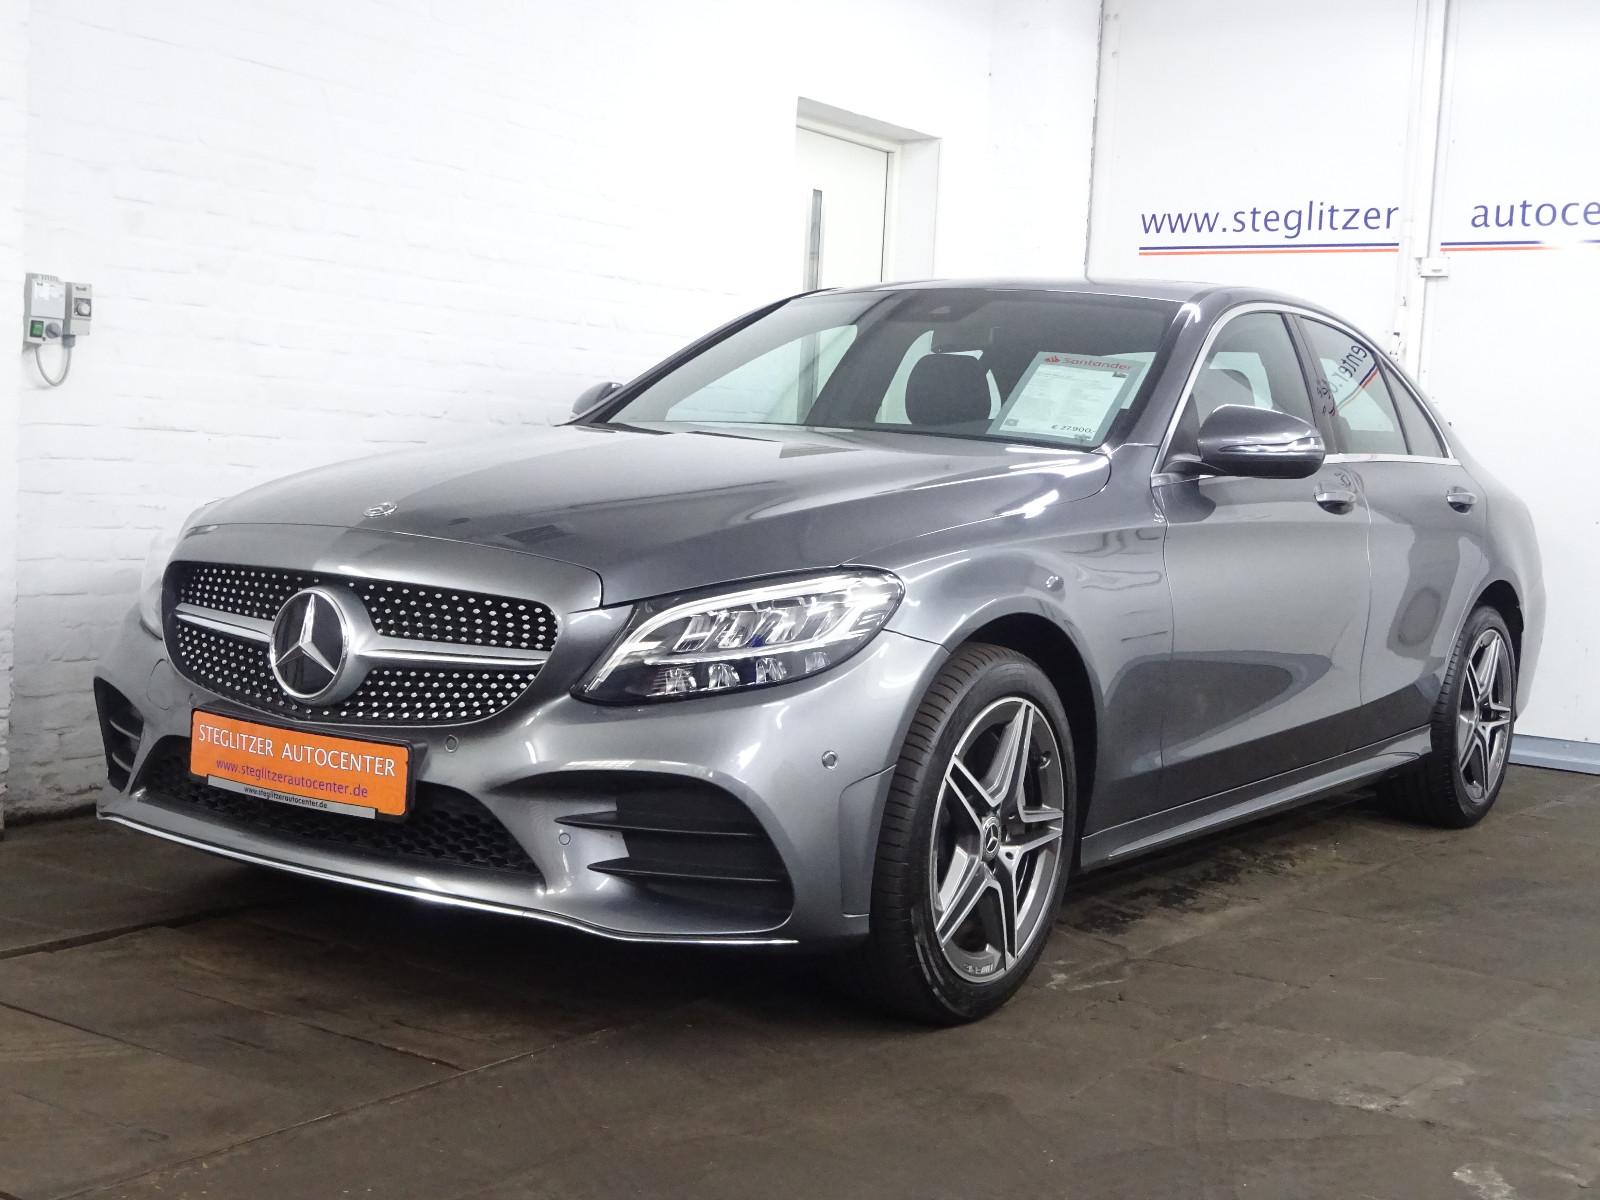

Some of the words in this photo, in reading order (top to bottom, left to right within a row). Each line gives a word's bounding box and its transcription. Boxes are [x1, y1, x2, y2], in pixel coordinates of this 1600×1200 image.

[1140, 200, 1399, 239] www.steglitzer
[1470, 199, 1600, 228] autoce
[1061, 356, 1131, 370] Santander
[198, 724, 274, 758] STEGLITZER
[281, 742, 396, 777] AUTOCENTER
[216, 759, 368, 798] www.steglitzerautocenter.de
[244, 786, 328, 809] www.steglitzerautocenter.de
